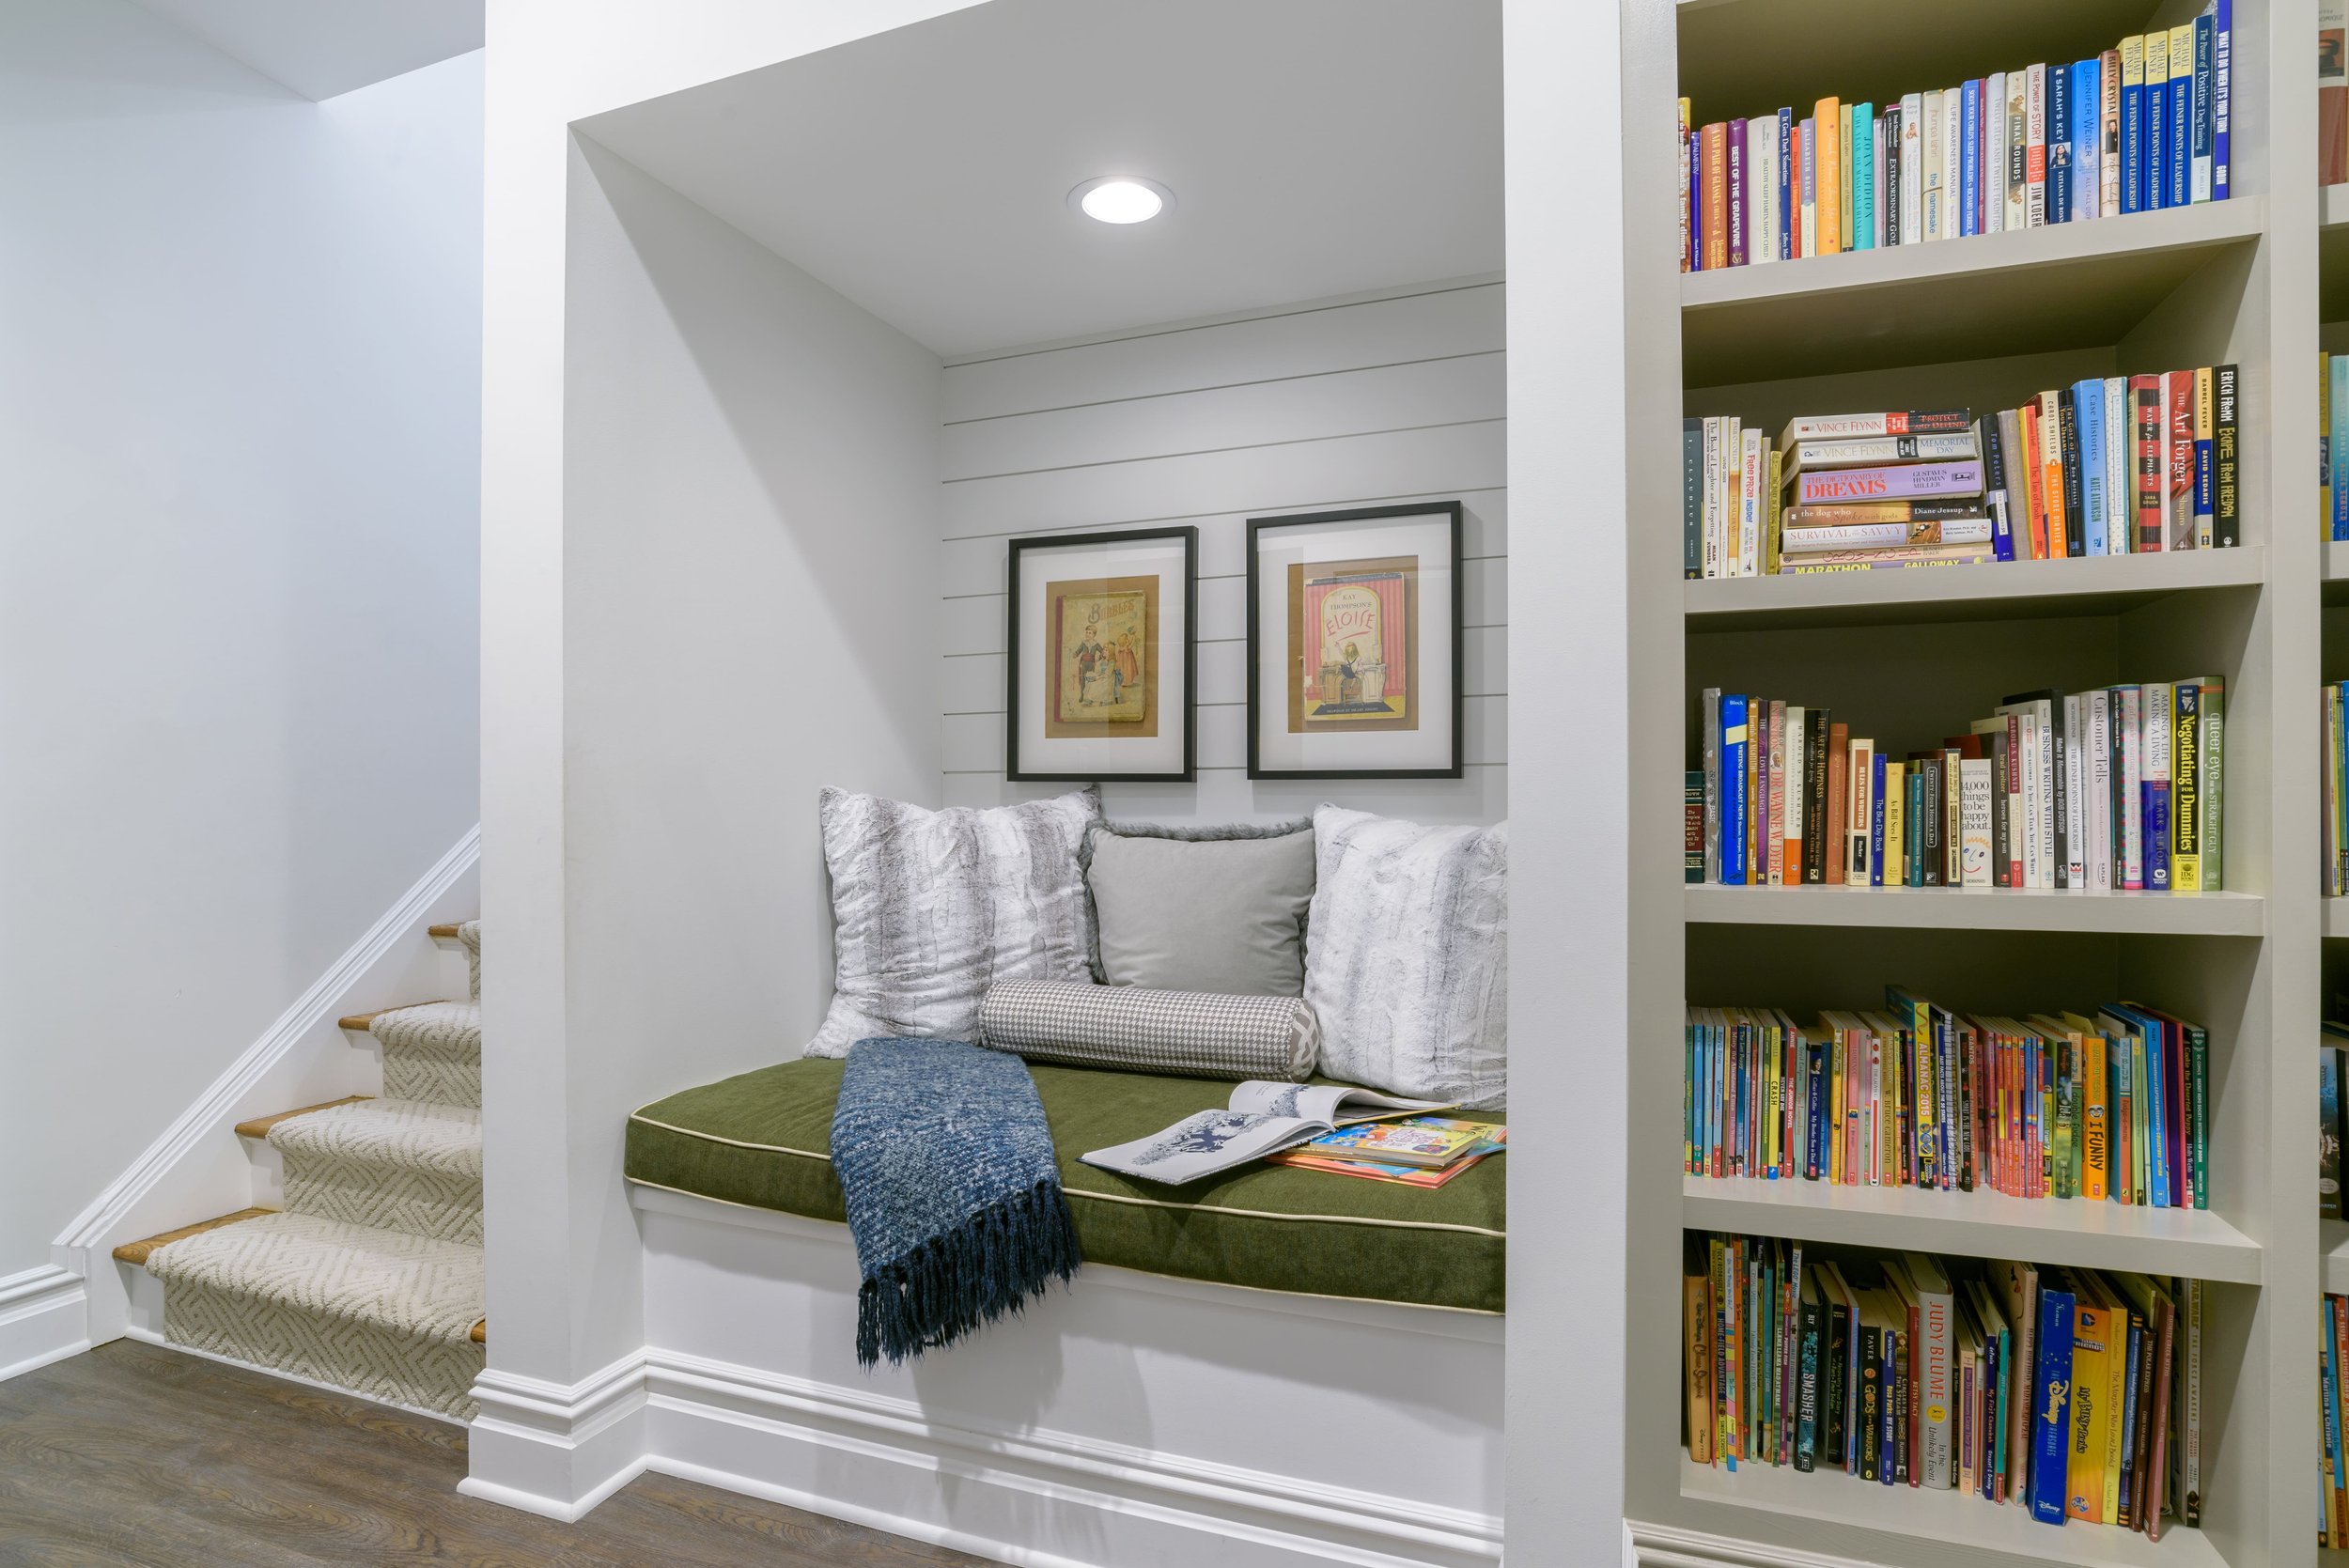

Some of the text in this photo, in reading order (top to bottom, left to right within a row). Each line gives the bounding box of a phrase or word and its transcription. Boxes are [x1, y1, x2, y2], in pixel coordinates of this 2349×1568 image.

[2200, 28, 2208, 39] The
[2172, 39, 2181, 67] FEINER
[2181, 33, 2189, 69] MICHAEL
[2084, 66, 2093, 115] JENNIFER
[2108, 56, 2117, 116] BILLY CRYSTAL
[2198, 71, 2208, 106] Positive
[2196, 109, 2204, 122] Dog
[2217, 31, 2229, 185] WHAT TO DO WHEN IT'S YOUR TURN GODIN
[2032, 114, 2041, 140] STORY
[2084, 118, 2094, 157] WEINER
[2175, 125, 2184, 149] POINTS
[2196, 124, 2204, 149] Training
[2175, 151, 2183, 161] OF
[1732, 169, 1739, 179] OF
[2174, 163, 2183, 203] LEADERSHIP
[2030, 187, 2042, 200] JIM
[2090, 396, 2098, 415] Case
[1816, 420, 1881, 433] VINCE FLYNN
[2175, 410, 2190, 433] Art
[1920, 438, 1969, 447] MEMORIAL
[2218, 371, 2234, 517] ERICH FROMM ESCAPE FROM FREEDOM
[1993, 455, 2001, 485] Peters
[2170, 439, 2191, 485] Forger
[1708, 464, 1717, 490] Laughter
[1806, 481, 1887, 498] DREAMS
[2091, 477, 2100, 491] KATE
[1937, 506, 1963, 515] Jessup
[2091, 493, 2101, 521] ATKINSON
[2176, 495, 2186, 525] Shapiro
[1708, 506, 1717, 537] Forgetting
[1795, 564, 1871, 574] MARATHON
[1326, 610, 1376, 636] ELOISE
[1817, 750, 1825, 759] OF
[2094, 697, 2107, 784] Customer Tells
[2178, 716, 2195, 784] Negotiating
[2205, 713, 2220, 779] queer eye
[1769, 771, 1782, 872] DR. WAYNE W. DYER
[2181, 795, 2194, 850] Dummies
[2000, 832, 2007, 841] my
[1919, 1043, 1929, 1115] ALMANAC 2015
[2090, 1131, 2104, 1171] FUNNY
[1930, 1301, 1944, 1399] JUDY BLUME
[1800, 1374, 1814, 1421] SMASHER
[2322, 1377, 2330, 1405] Martina
[1865, 1425, 1874, 1461] WARRIORS
[1927, 1427, 1937, 1481] Unlikely Event
[1938, 1445, 1947, 1453] In
